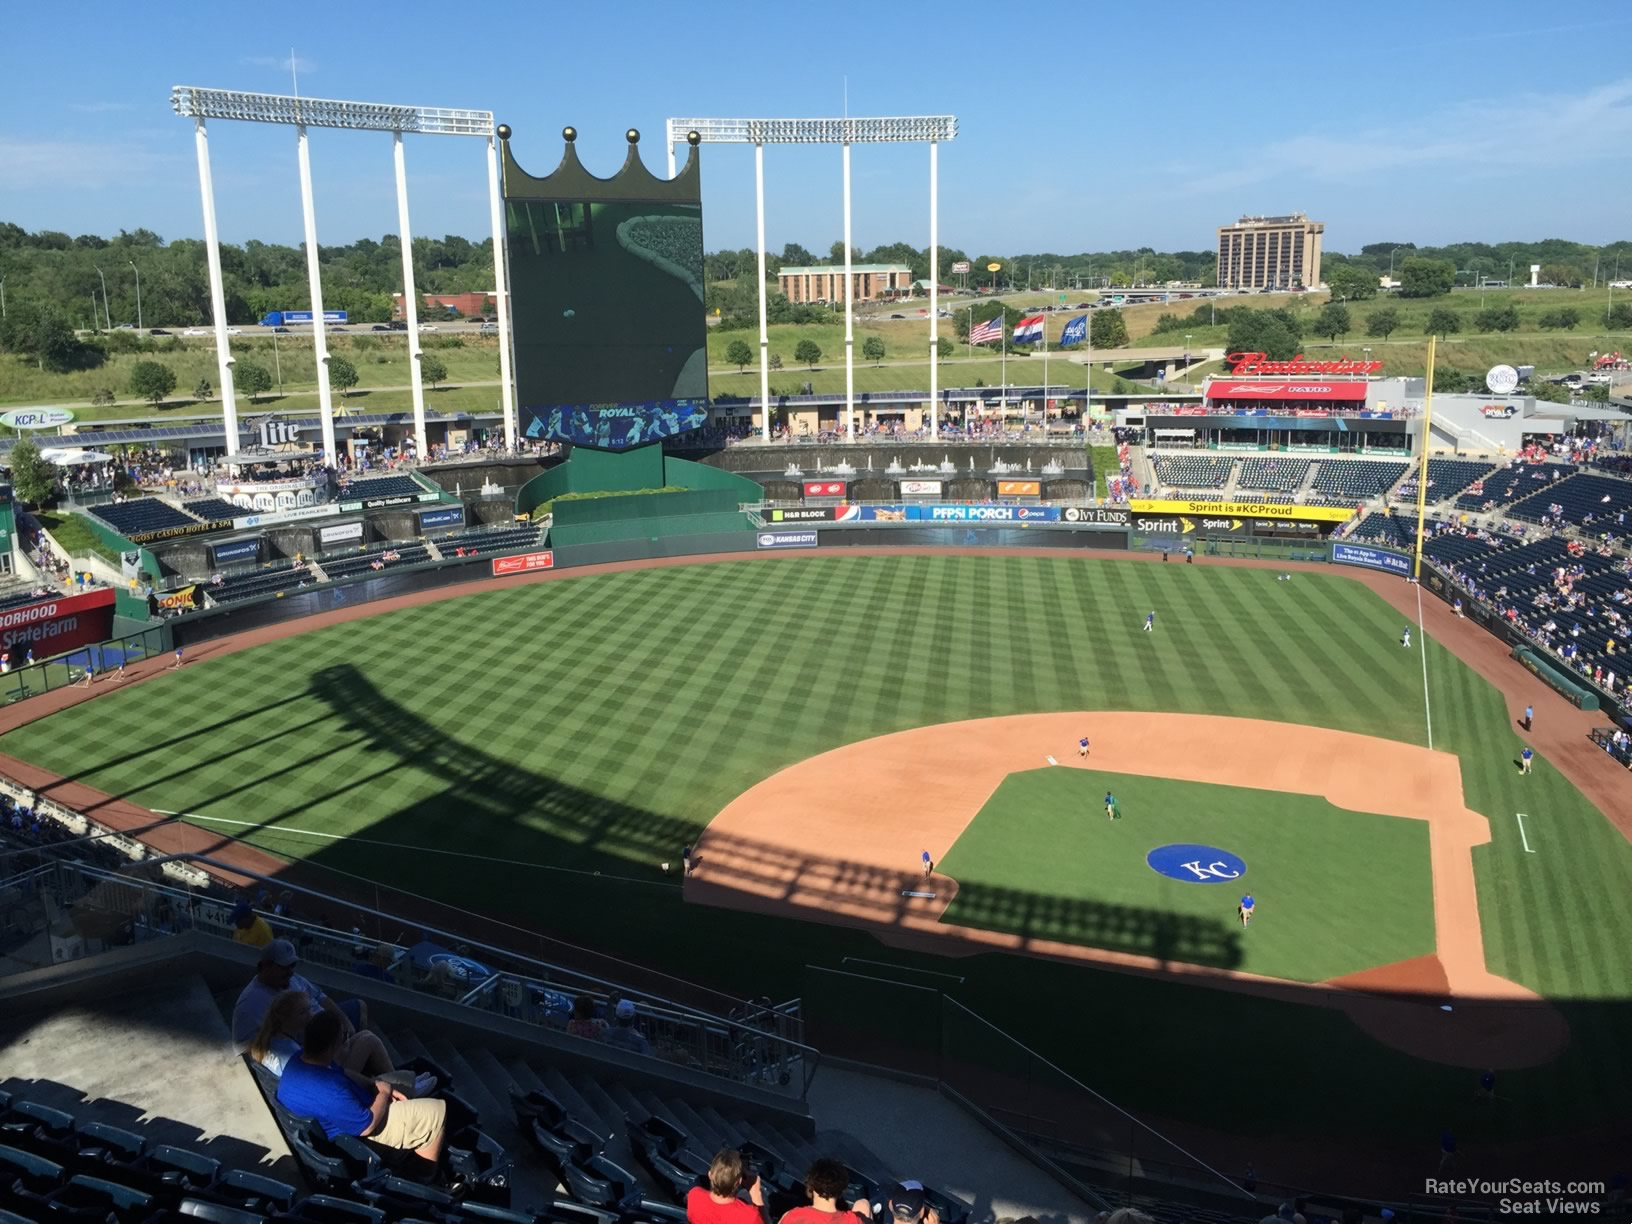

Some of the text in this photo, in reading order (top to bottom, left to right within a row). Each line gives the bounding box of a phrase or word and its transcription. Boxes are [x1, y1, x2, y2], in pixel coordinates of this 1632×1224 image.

[1226, 352, 1384, 376] Budweiser
[600, 408, 636, 418] ROYAL
[1485, 408, 1512, 418] RIVALS
[15, 414, 46, 426] KCP&L
[258, 421, 300, 450] Lite
[933, 508, 1012, 519] PEPSI PORCH
[1189, 502, 1292, 515] Sprint is #KCProud
[157, 528, 184, 538] CASINO
[186, 524, 209, 534] HOTEL
[219, 520, 232, 528] SPA
[1138, 519, 1178, 532] Sprint
[1203, 519, 1229, 530] Sprint
[160, 593, 193, 608] SONIC
[1180, 860, 1240, 880] KC
